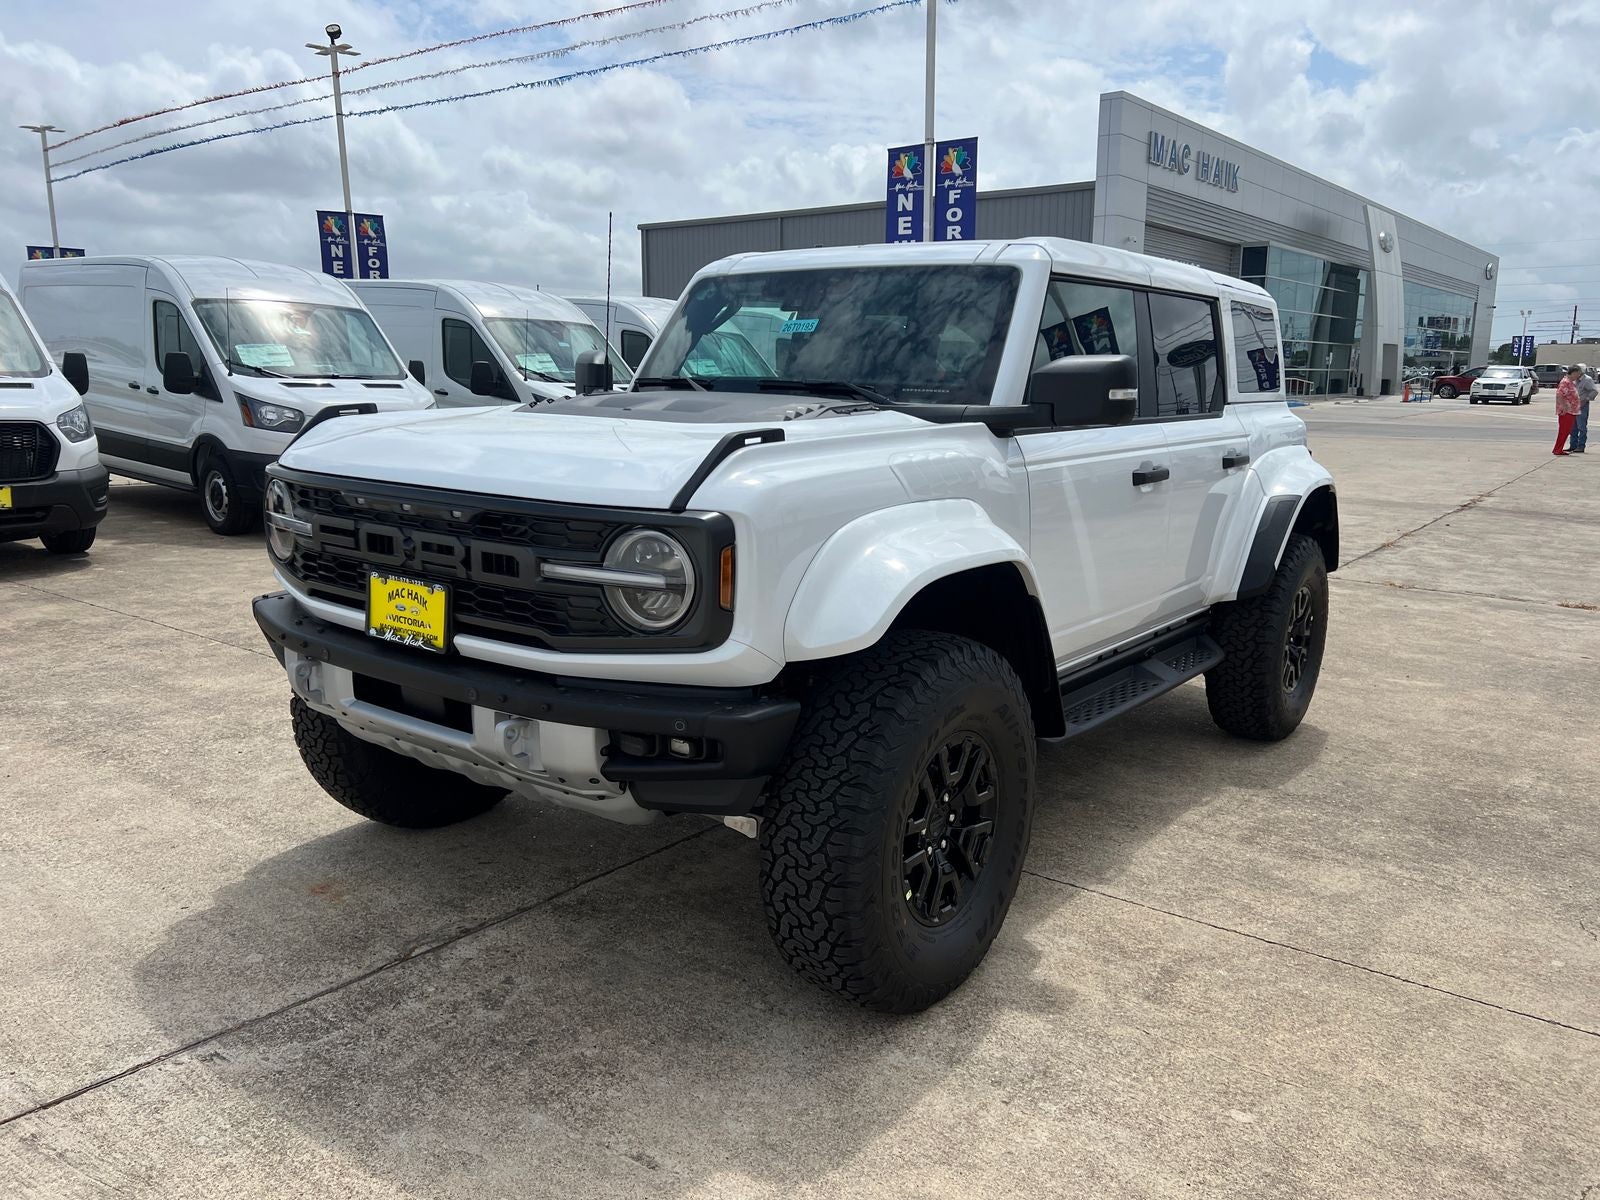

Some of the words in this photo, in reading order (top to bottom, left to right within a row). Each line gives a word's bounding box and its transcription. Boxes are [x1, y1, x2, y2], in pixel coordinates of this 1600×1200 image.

[1149, 131, 1191, 174] MAC
[1197, 151, 1239, 193] HAIK
[894, 192, 916, 244] NE
[331, 244, 345, 275] NE
[312, 514, 537, 590] FORD
[388, 588, 405, 603] MAC
[407, 588, 428, 611] HAIK
[392, 614, 425, 629] VICTORIA
